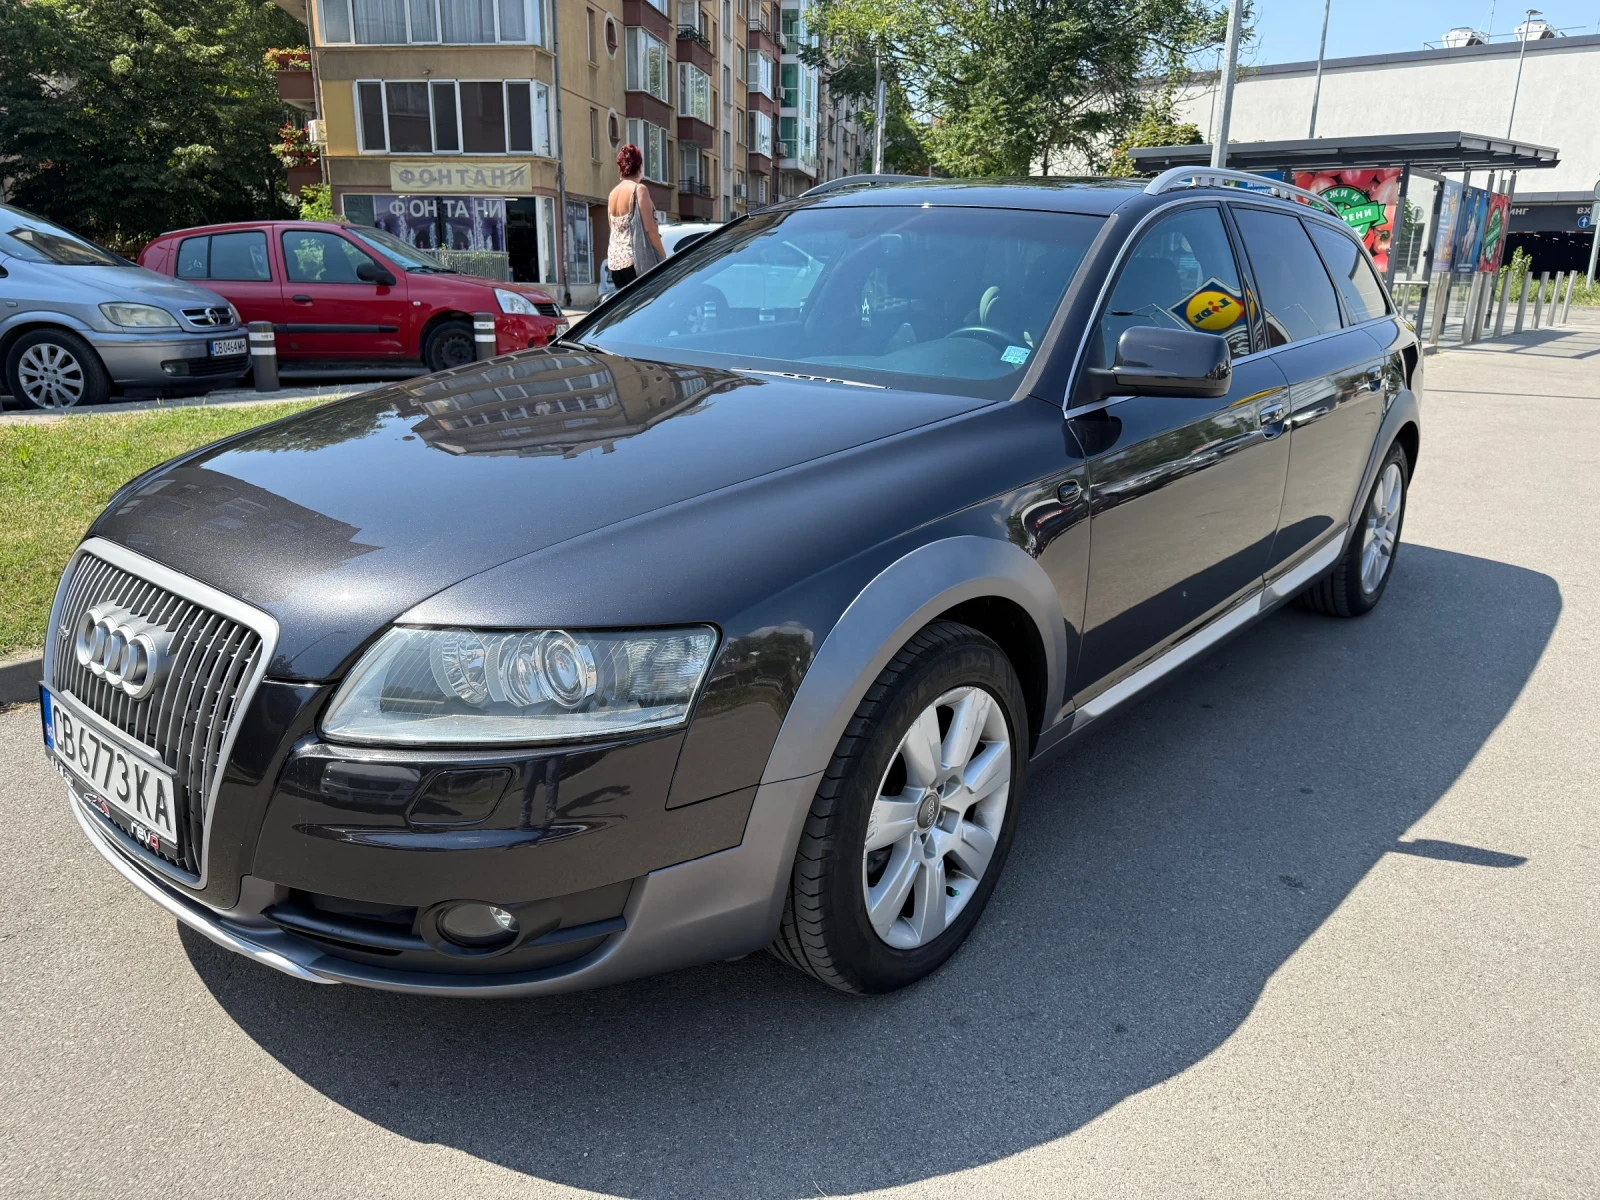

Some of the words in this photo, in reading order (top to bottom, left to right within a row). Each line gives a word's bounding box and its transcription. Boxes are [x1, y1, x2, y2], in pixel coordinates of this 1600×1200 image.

[398, 168, 525, 186] ФОНТАНИ
[1322, 189, 1348, 201] ЕЖИ
[1342, 208, 1372, 222] РЕНИ
